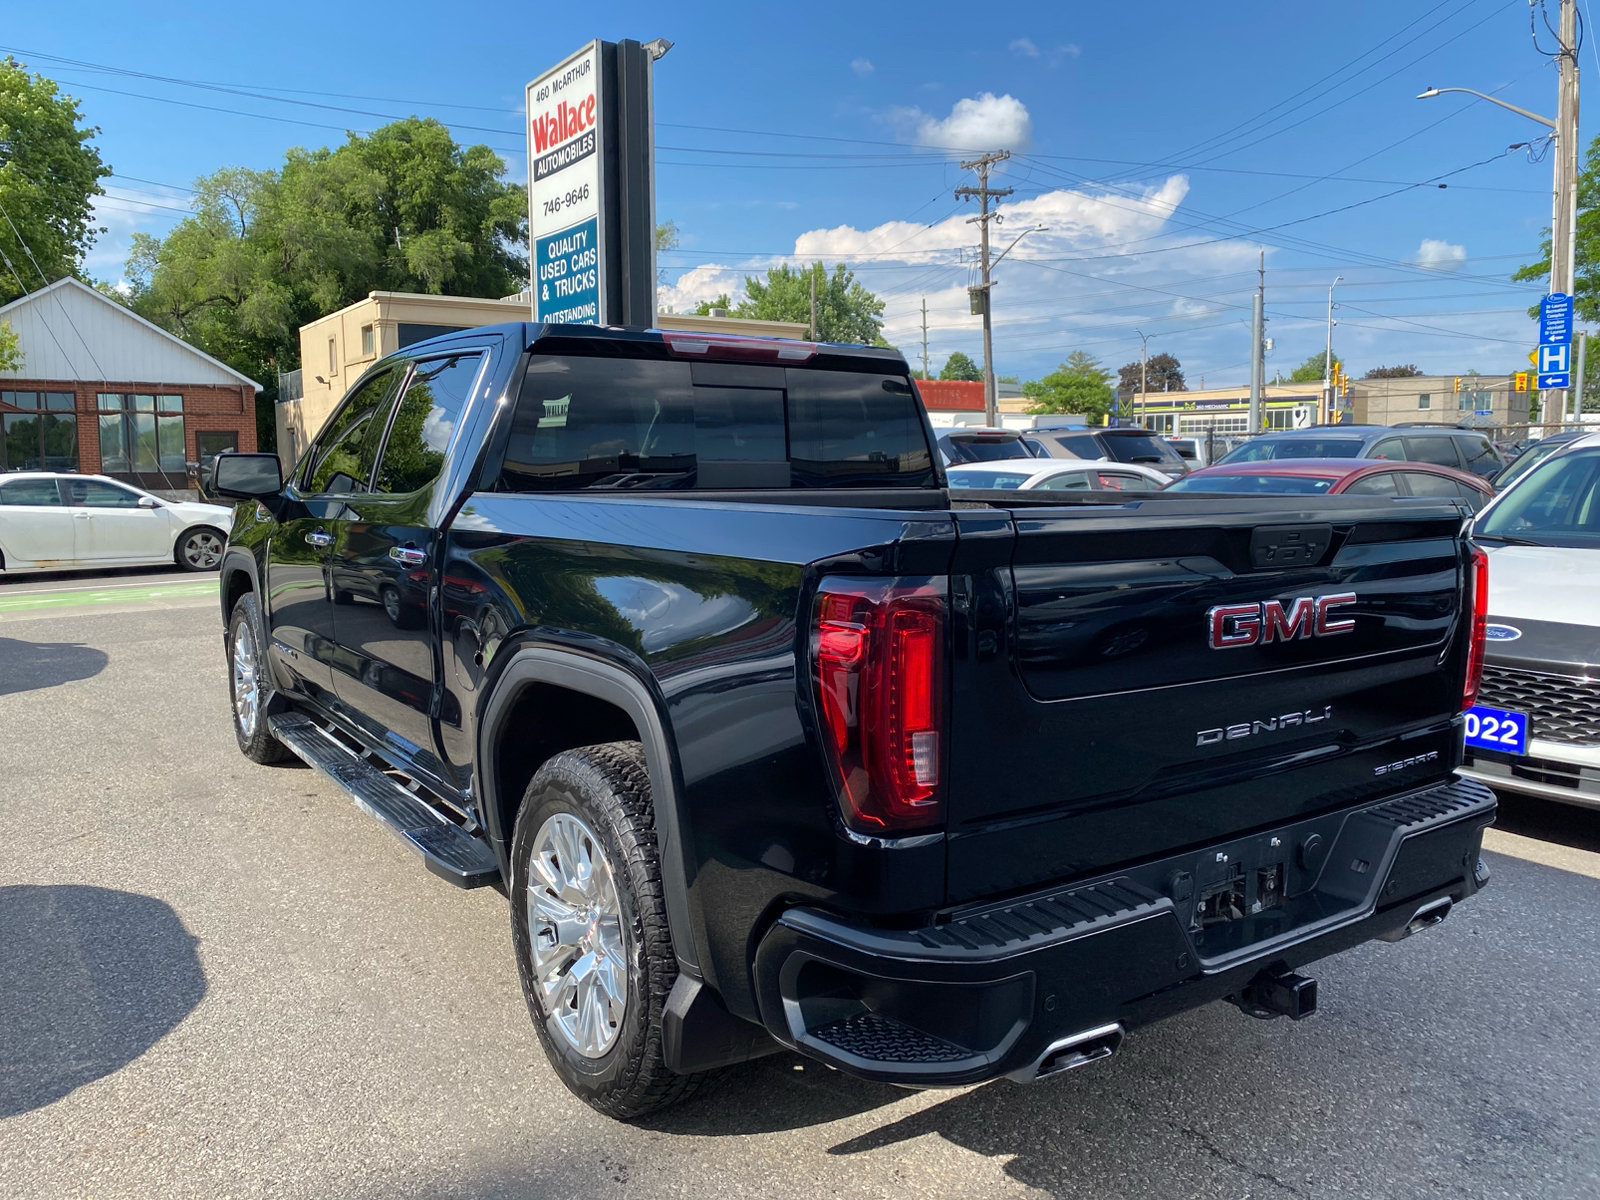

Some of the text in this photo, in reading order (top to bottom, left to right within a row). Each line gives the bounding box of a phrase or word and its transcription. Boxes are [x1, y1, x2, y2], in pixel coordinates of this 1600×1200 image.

[536, 59, 591, 103] 460 McARTHUR
[532, 93, 596, 154] Wallace
[537, 133, 594, 176] AUTOMOBILES
[543, 183, 590, 217] 746-9646
[548, 230, 588, 259] QUALITY
[540, 247, 596, 281] USED CARS
[541, 268, 596, 301] & TRUCKS
[543, 302, 596, 324] OUTSTANDING
[1543, 346, 1566, 371] H
[1208, 592, 1356, 649] GMC
[1196, 705, 1331, 747] DENALI
[1374, 751, 1438, 775] SIERRA
